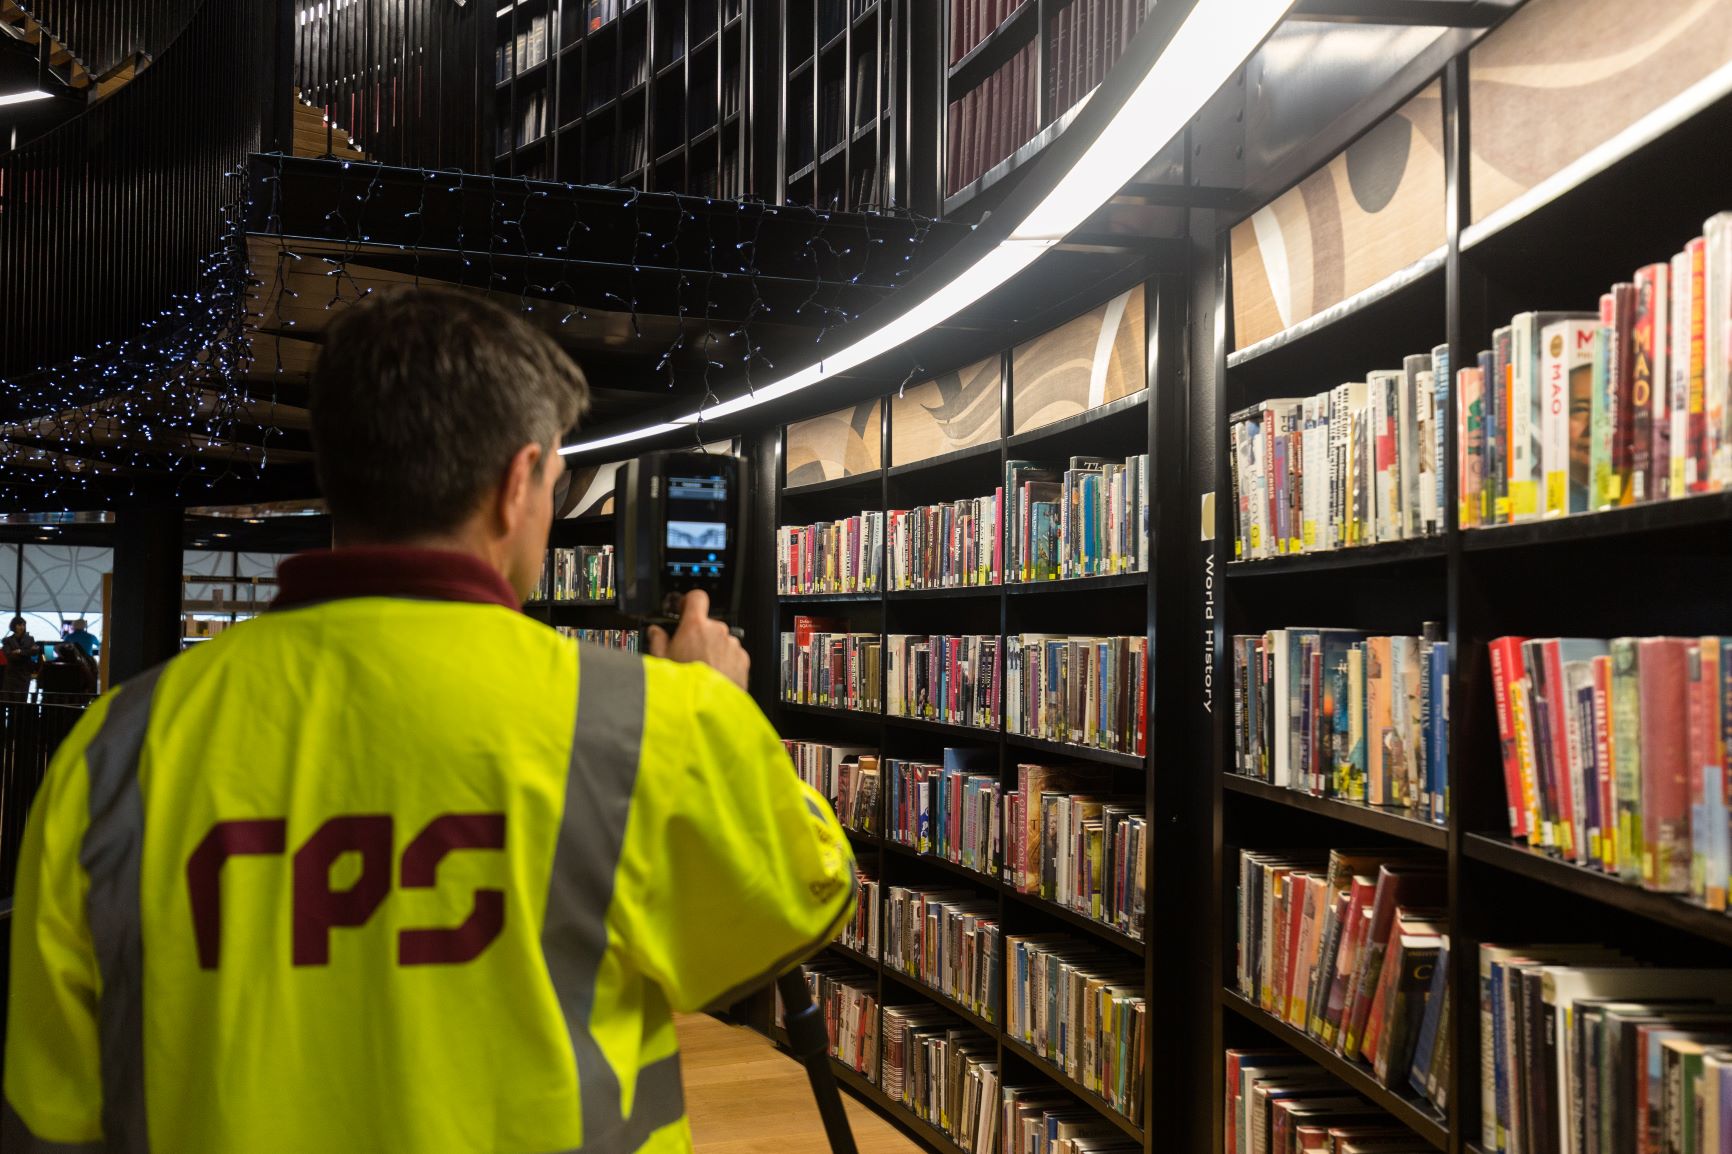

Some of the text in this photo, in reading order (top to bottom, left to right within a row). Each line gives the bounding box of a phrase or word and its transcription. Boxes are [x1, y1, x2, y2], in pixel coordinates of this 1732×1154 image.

[1551, 364, 1562, 415] MAO
[1632, 325, 1650, 407] MAO
[1266, 435, 1274, 470] KOSOVO
[1250, 469, 1260, 539] KOSOVO
[1203, 554, 1214, 713] World History
[1596, 690, 1609, 781] CHINA'S WORLD
[1018, 798, 1026, 833] GREEK
[187, 813, 506, 970] rps
